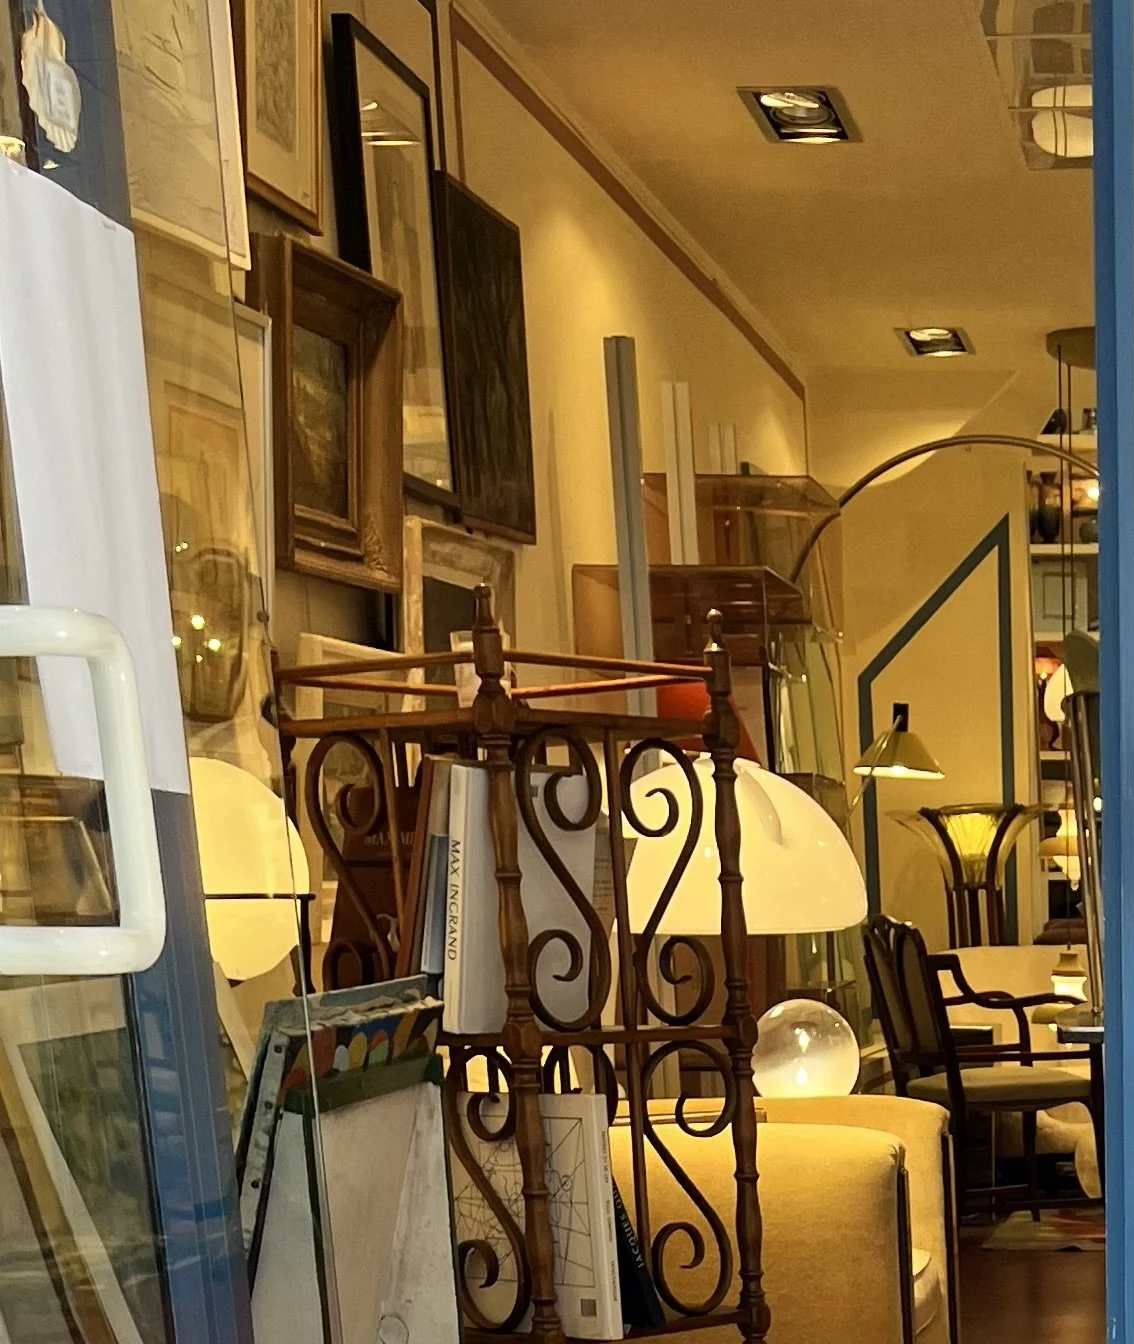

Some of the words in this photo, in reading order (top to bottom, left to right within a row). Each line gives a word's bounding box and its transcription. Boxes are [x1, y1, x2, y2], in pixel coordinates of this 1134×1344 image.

[450, 839, 461, 877] MAX
[447, 882, 460, 961] INGRAND
[619, 1213, 645, 1269] JACQUES
